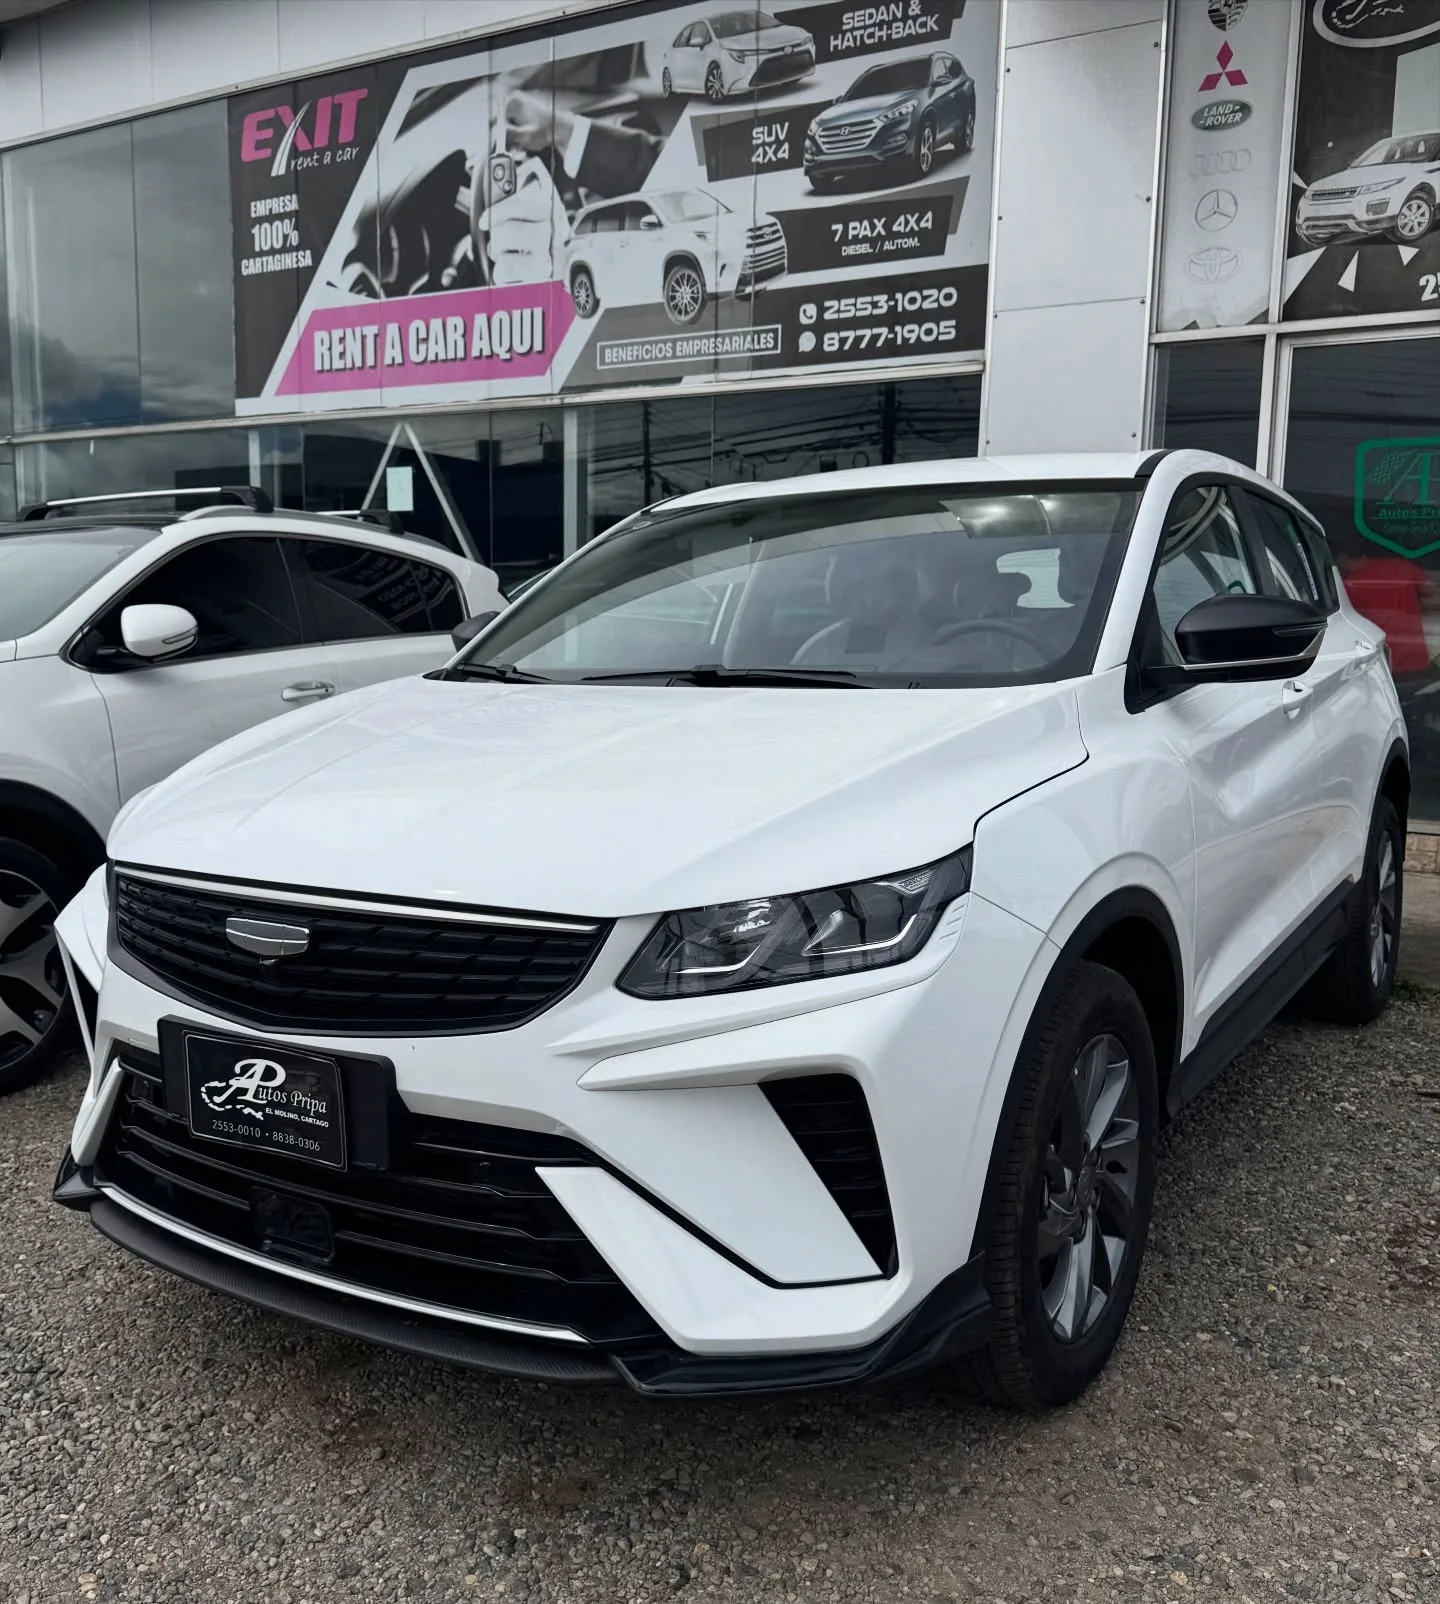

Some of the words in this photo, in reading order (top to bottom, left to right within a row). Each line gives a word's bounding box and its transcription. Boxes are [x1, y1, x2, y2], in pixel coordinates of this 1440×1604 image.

[842, 2, 903, 30] SEDAN
[908, 0, 921, 15] &
[829, 14, 939, 52] HATCH-BACK
[240, 88, 368, 177] EXIT
[752, 121, 790, 145] SUV
[290, 152, 320, 172] rent
[323, 151, 333, 164] a
[336, 145, 360, 163] car
[751, 141, 790, 164] 4X4
[250, 194, 299, 218] EMPRESA
[251, 218, 299, 252] 100%
[831, 224, 844, 242] 7
[848, 217, 886, 239] PAX
[892, 211, 933, 233] 4X4
[841, 242, 873, 256] DIESEL
[883, 237, 920, 251] AUTOM.
[241, 250, 312, 276] CARTAGINESA
[823, 287, 958, 320] 2553-1020
[313, 324, 381, 373] RENT
[384, 324, 404, 365] A
[409, 315, 466, 363] CAR
[471, 306, 545, 360] AQUI
[604, 340, 673, 364] BENEFICIOS
[676, 333, 775, 358] EMPRESARIALES
[823, 321, 957, 352] 8777-1905
[290, 1091, 327, 1116] Pripa
[212, 1120, 261, 1138] 2553-0010
[272, 1132, 321, 1151] 8838-0306
[300, 1113, 329, 1128] CARTAGO
